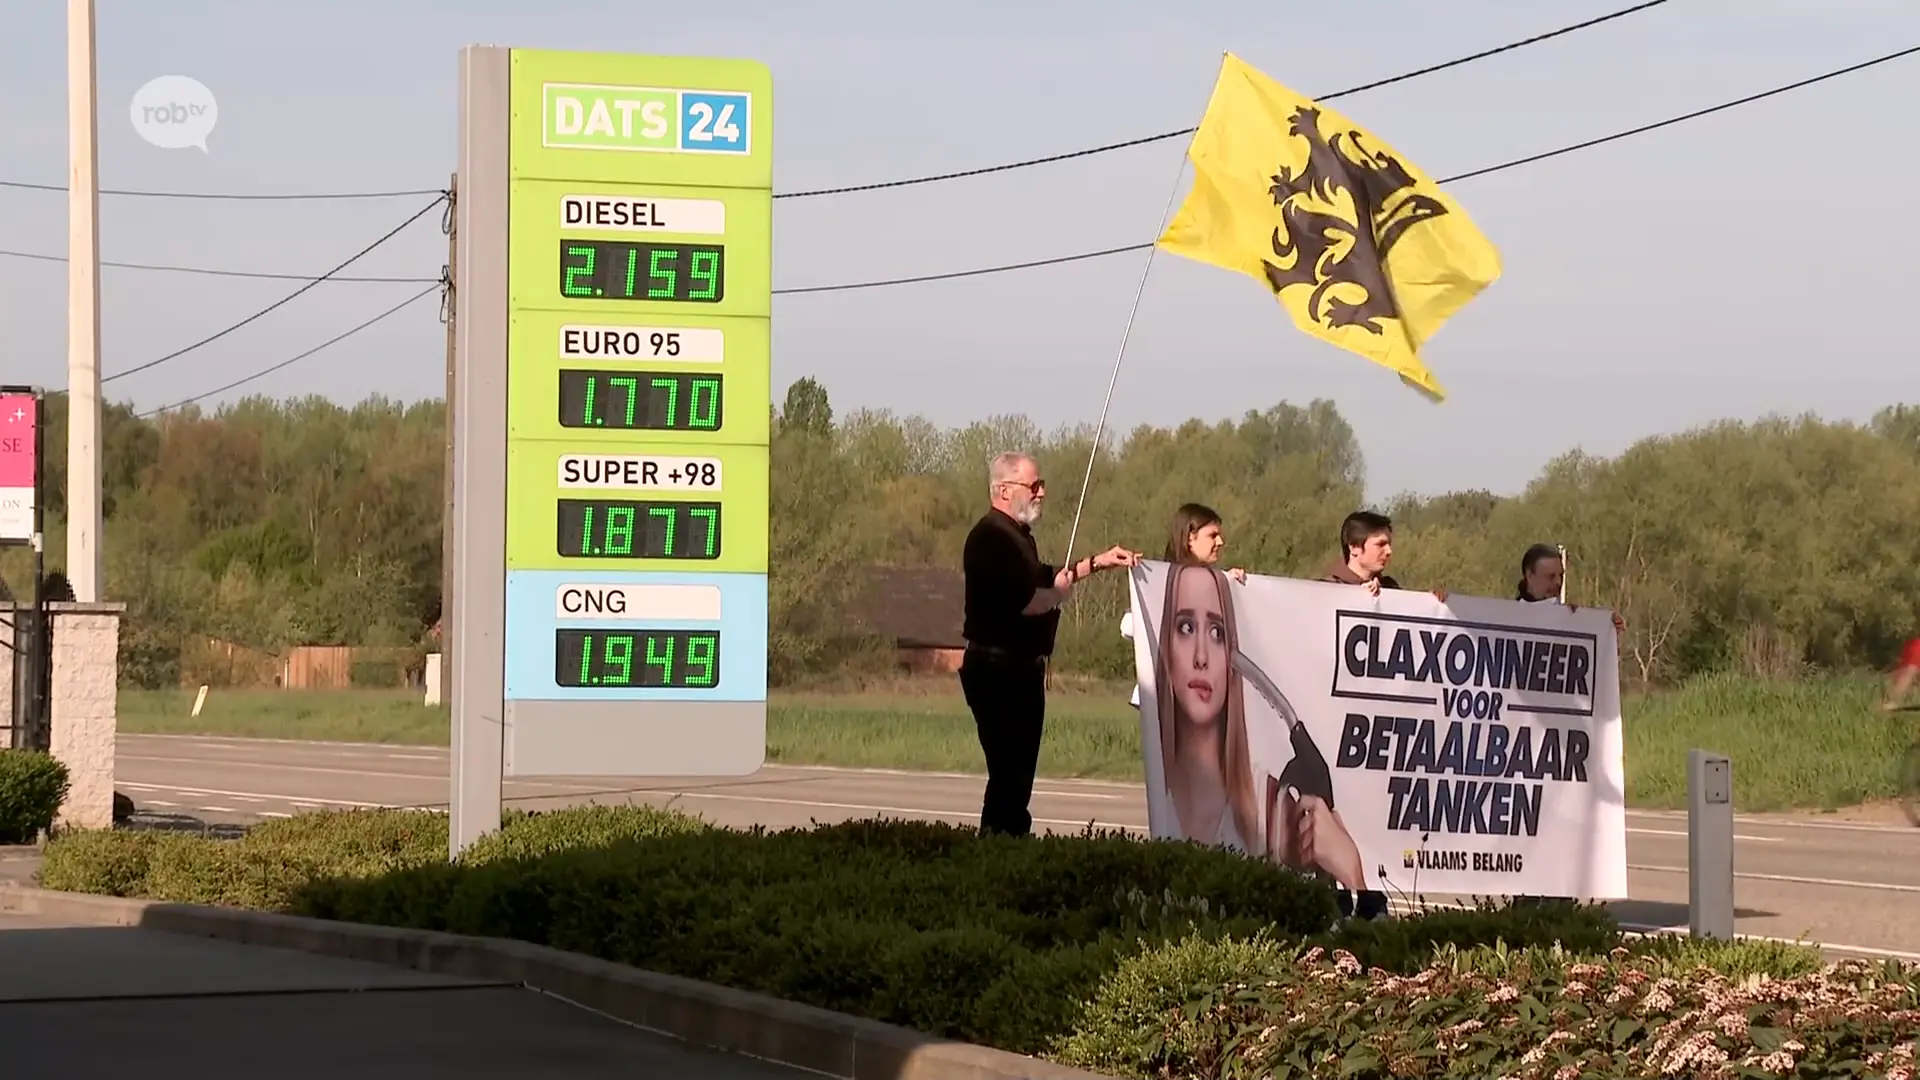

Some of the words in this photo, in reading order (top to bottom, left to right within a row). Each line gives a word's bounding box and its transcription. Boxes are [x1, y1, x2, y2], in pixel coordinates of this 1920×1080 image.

[555, 96, 668, 139] DATS
[688, 102, 740, 142] 24
[566, 200, 666, 227] DIESEL
[564, 246, 720, 299] 2.159
[564, 330, 640, 355] EURO
[650, 332, 681, 356] 95
[583, 376, 720, 428] 1.770
[564, 459, 659, 485] SUPER
[668, 462, 717, 487] +98
[581, 506, 718, 556] 1.877
[562, 589, 627, 613] CNG
[580, 635, 717, 685] 1.949
[1344, 624, 1591, 696] CLAXONNEER
[1442, 688, 1503, 721] VOOR
[1336, 713, 1590, 782] BETAALBAAR
[1387, 776, 1543, 837] TANKEN
[1416, 849, 1468, 871] VLAAMS
[1472, 851, 1523, 873] BELANG
